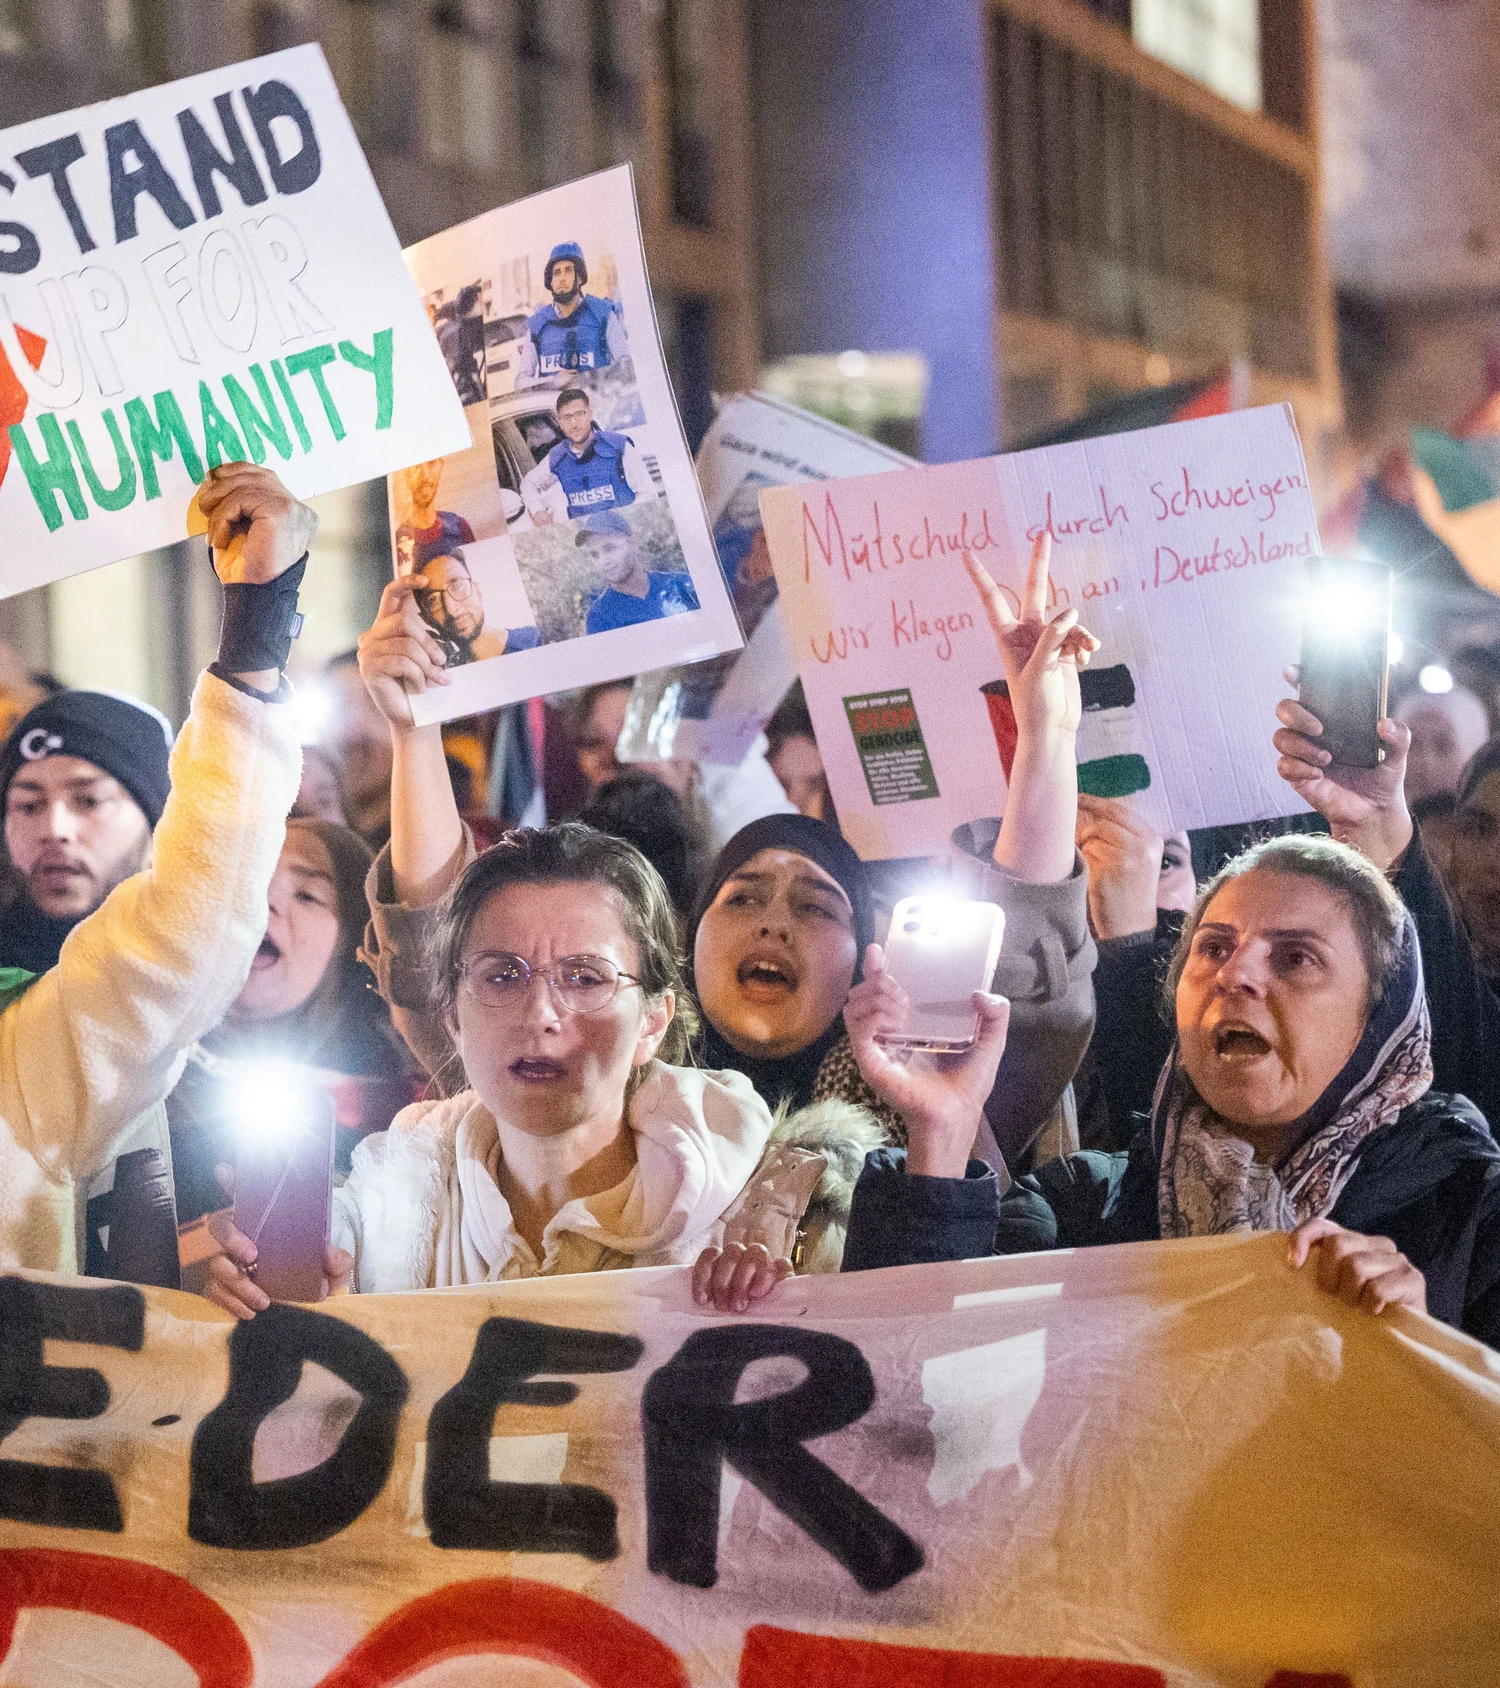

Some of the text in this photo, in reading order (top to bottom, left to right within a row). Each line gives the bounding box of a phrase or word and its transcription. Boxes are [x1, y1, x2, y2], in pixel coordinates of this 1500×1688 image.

[141, 213, 337, 366] FOR
[8, 327, 393, 533] HUMANITY
[570, 486, 613, 504] PRESS
[1026, 486, 1129, 544] durch
[855, 708, 915, 734] STOP
